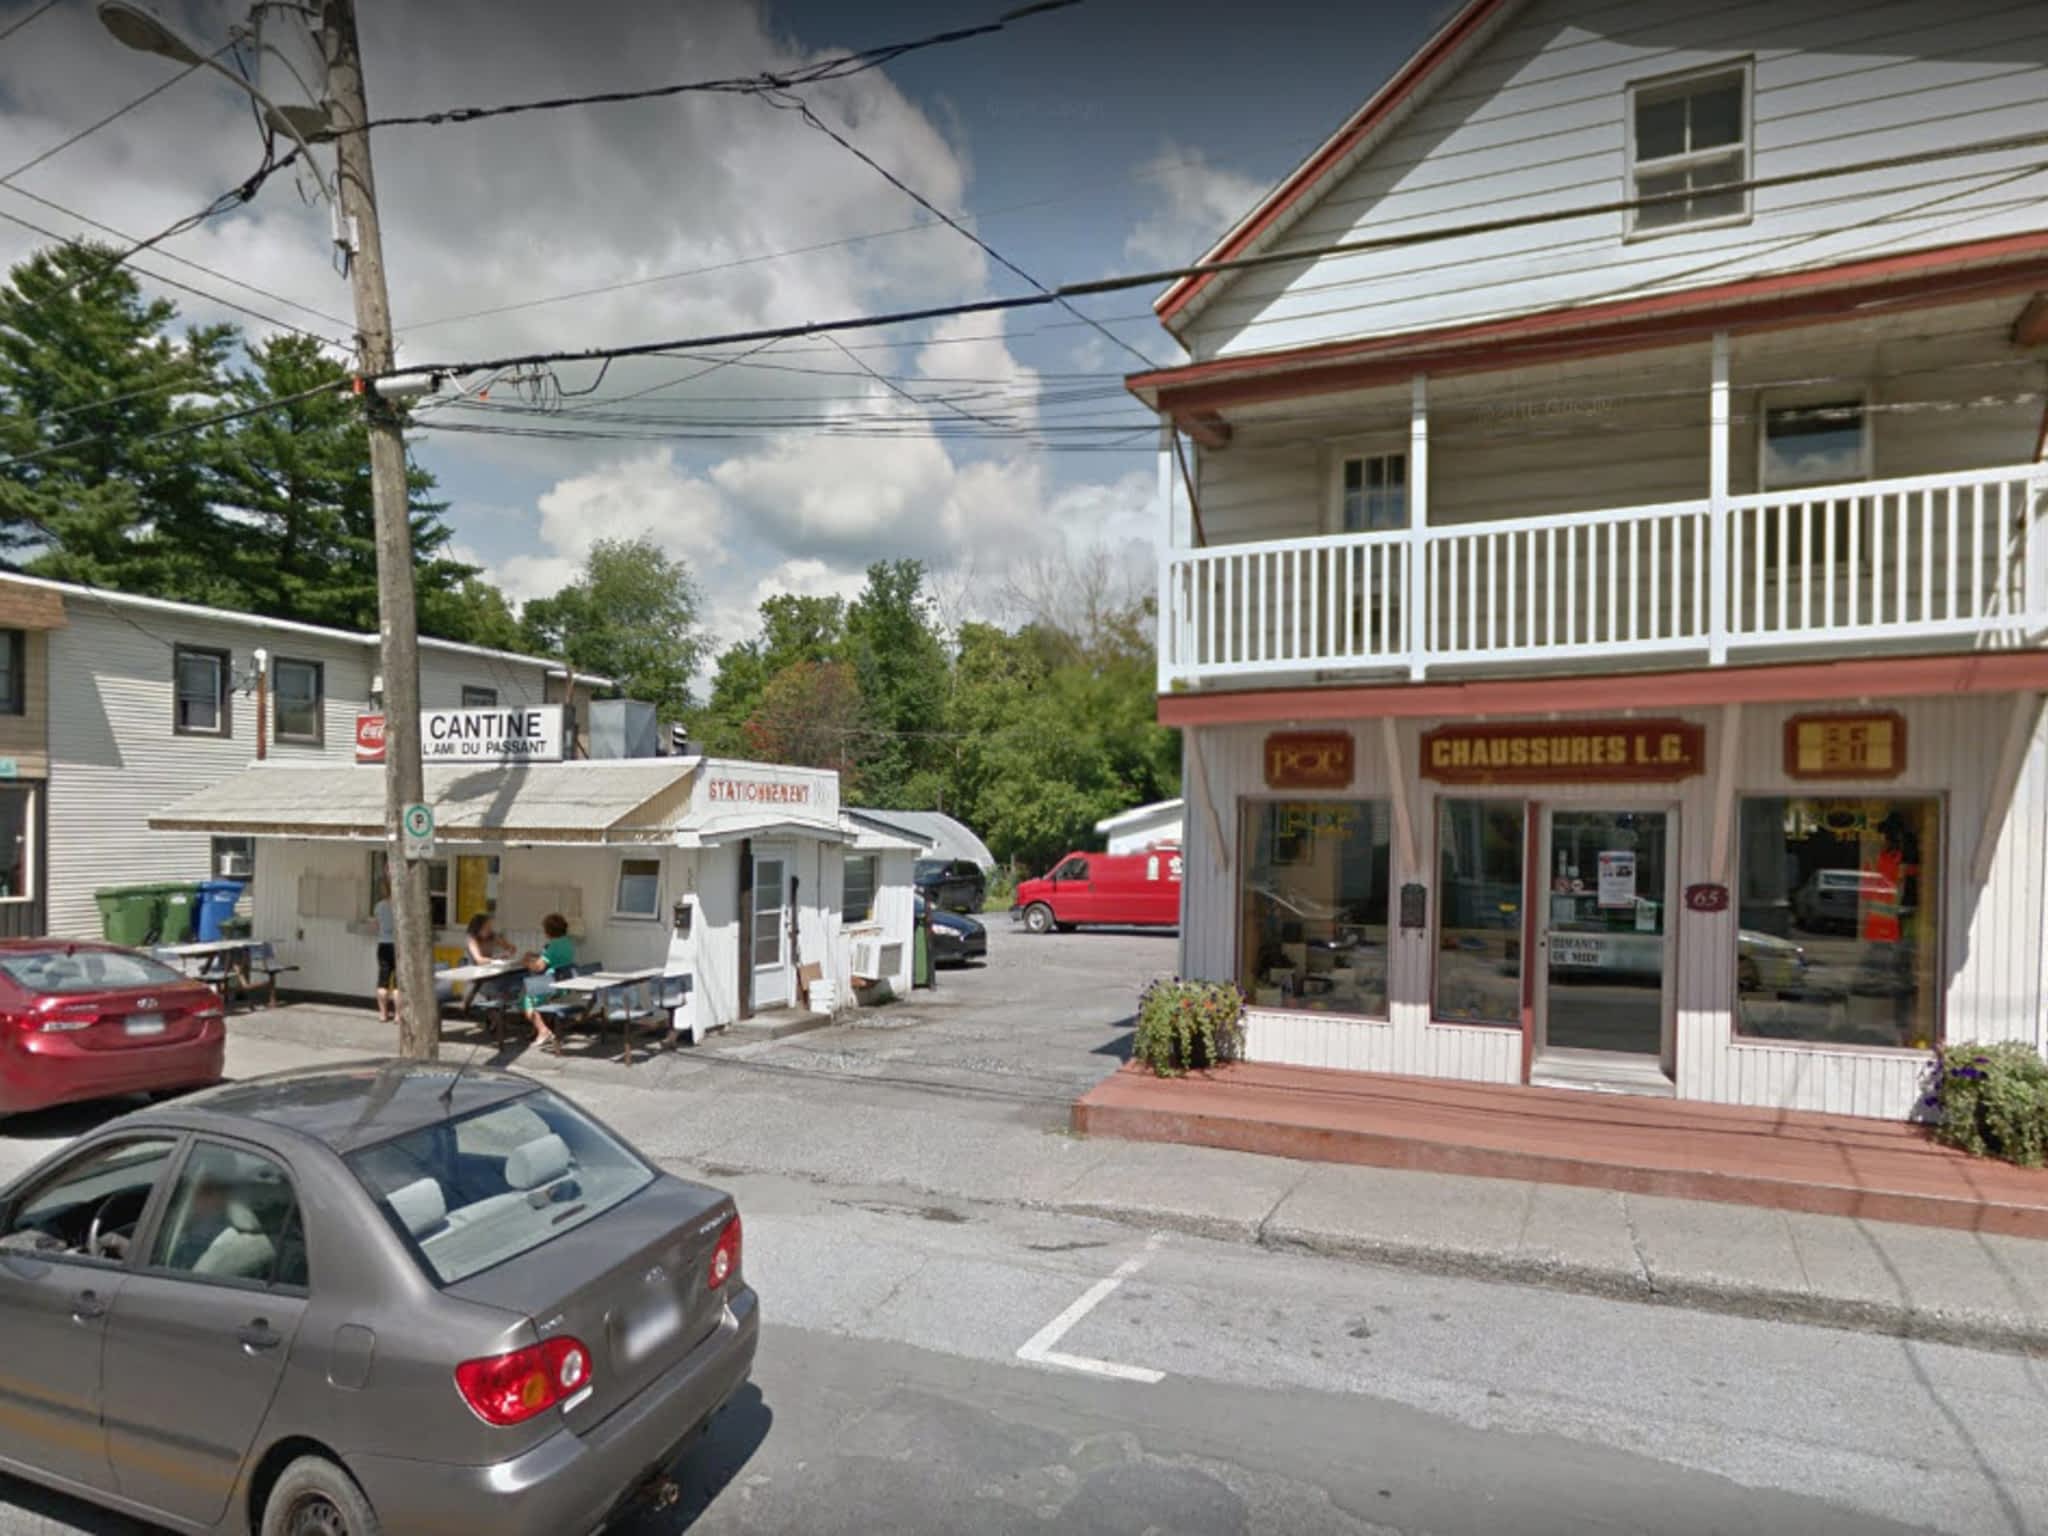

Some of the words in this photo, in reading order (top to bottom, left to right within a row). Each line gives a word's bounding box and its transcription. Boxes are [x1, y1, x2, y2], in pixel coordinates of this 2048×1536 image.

[429, 712, 542, 740] CANTINE
[423, 742, 456, 756] L'AMI
[461, 742, 481, 755] DU
[485, 740, 548, 754] PASSANT
[1431, 736, 1627, 767] CHAUSSURES
[1634, 733, 1691, 763] L.G.
[1693, 888, 1720, 907] 65
